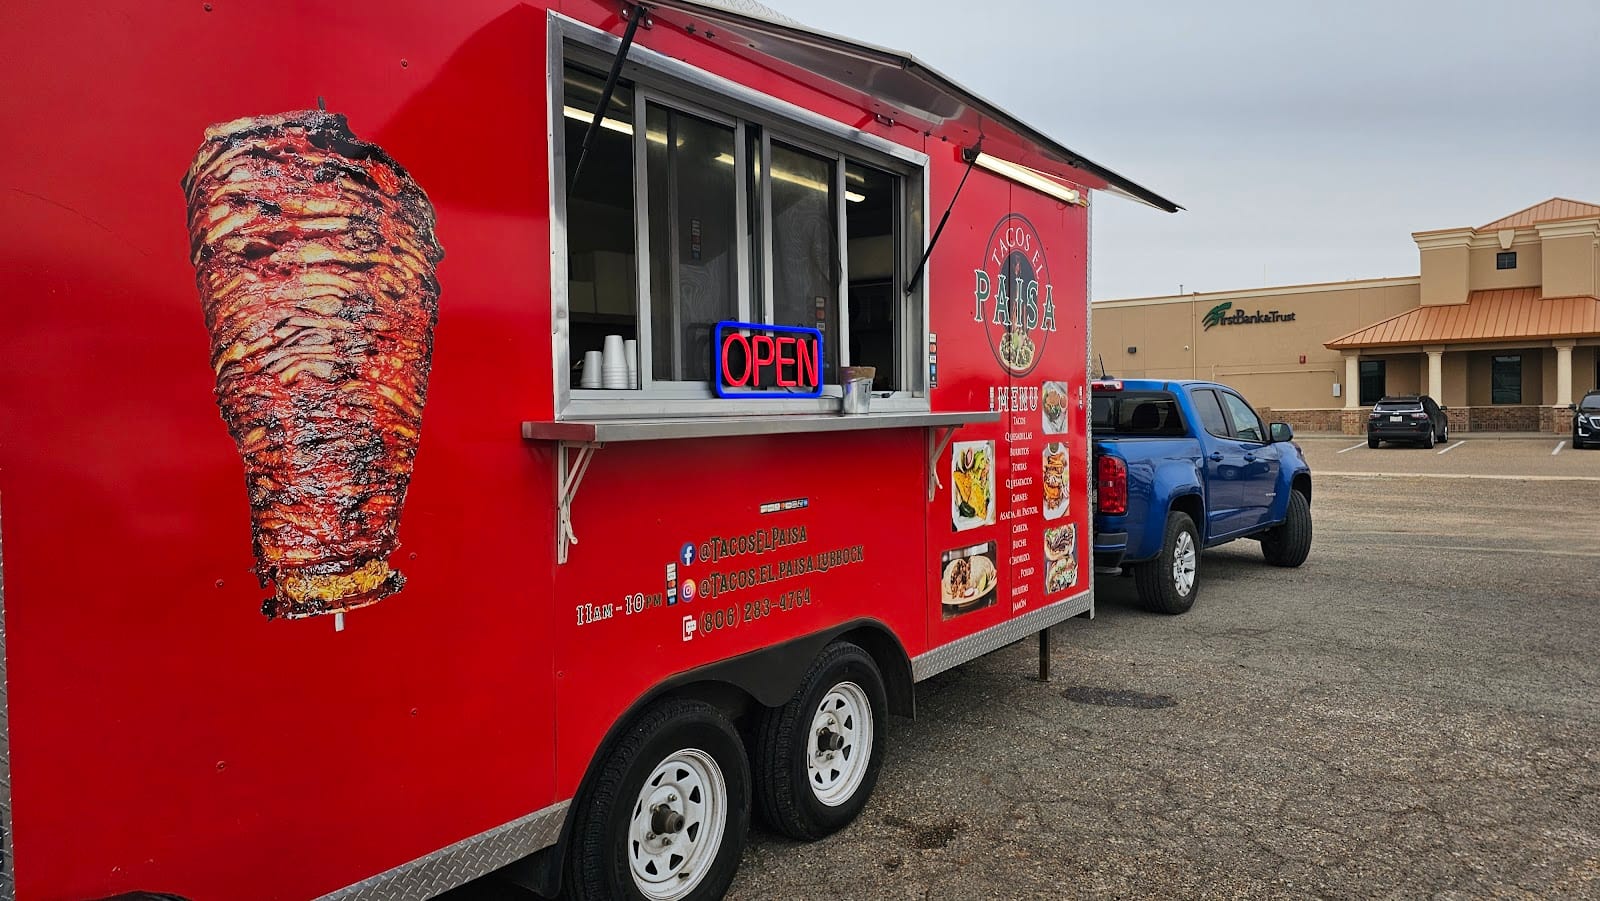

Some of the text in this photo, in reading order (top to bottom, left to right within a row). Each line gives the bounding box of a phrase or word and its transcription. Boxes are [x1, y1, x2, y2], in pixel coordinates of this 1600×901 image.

[992, 227, 1045, 279] TACOS EL
[974, 268, 1057, 331] PAISA
[722, 333, 819, 387] OPEN
[997, 386, 1038, 412] MENU
[699, 587, 813, 638] (806) 283-4764
